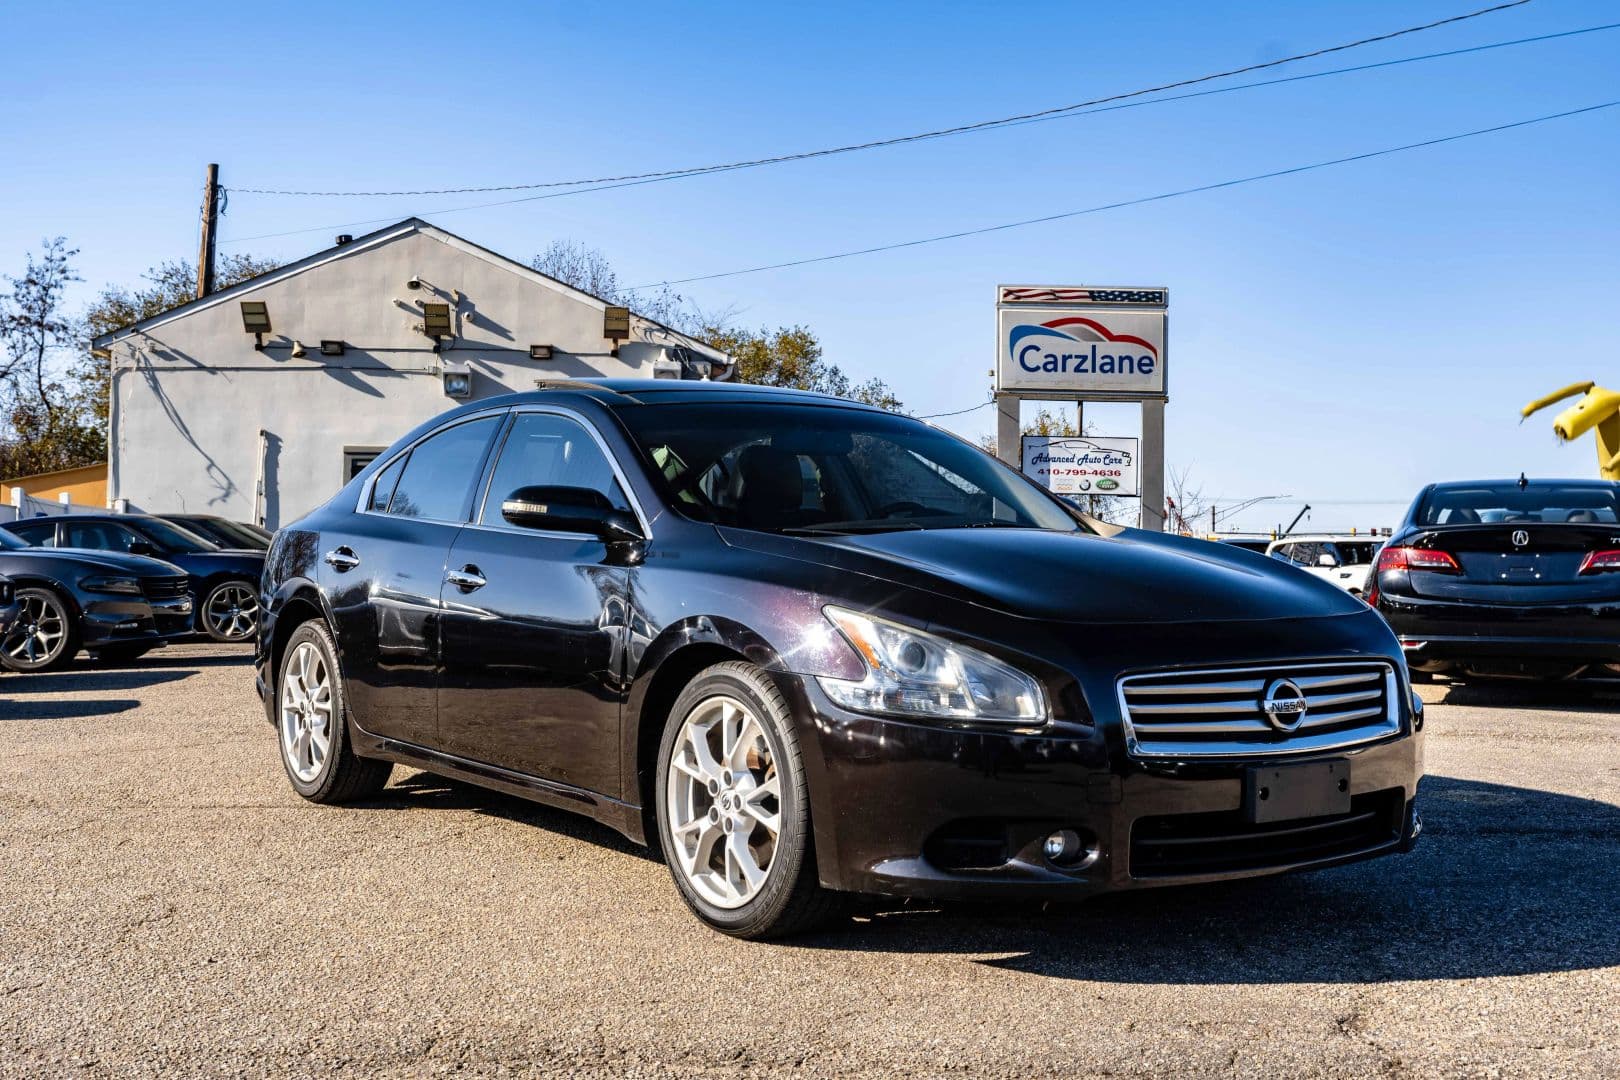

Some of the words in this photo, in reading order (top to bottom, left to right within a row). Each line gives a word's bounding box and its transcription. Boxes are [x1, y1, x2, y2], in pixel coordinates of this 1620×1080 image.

[1018, 344, 1155, 375] Carzlane
[1031, 452, 1076, 465] Advanced
[1077, 453, 1102, 466] Auto
[1103, 454, 1123, 466] Care
[1037, 468, 1122, 477] 410-799-4636
[1271, 700, 1306, 711] NISSAN
